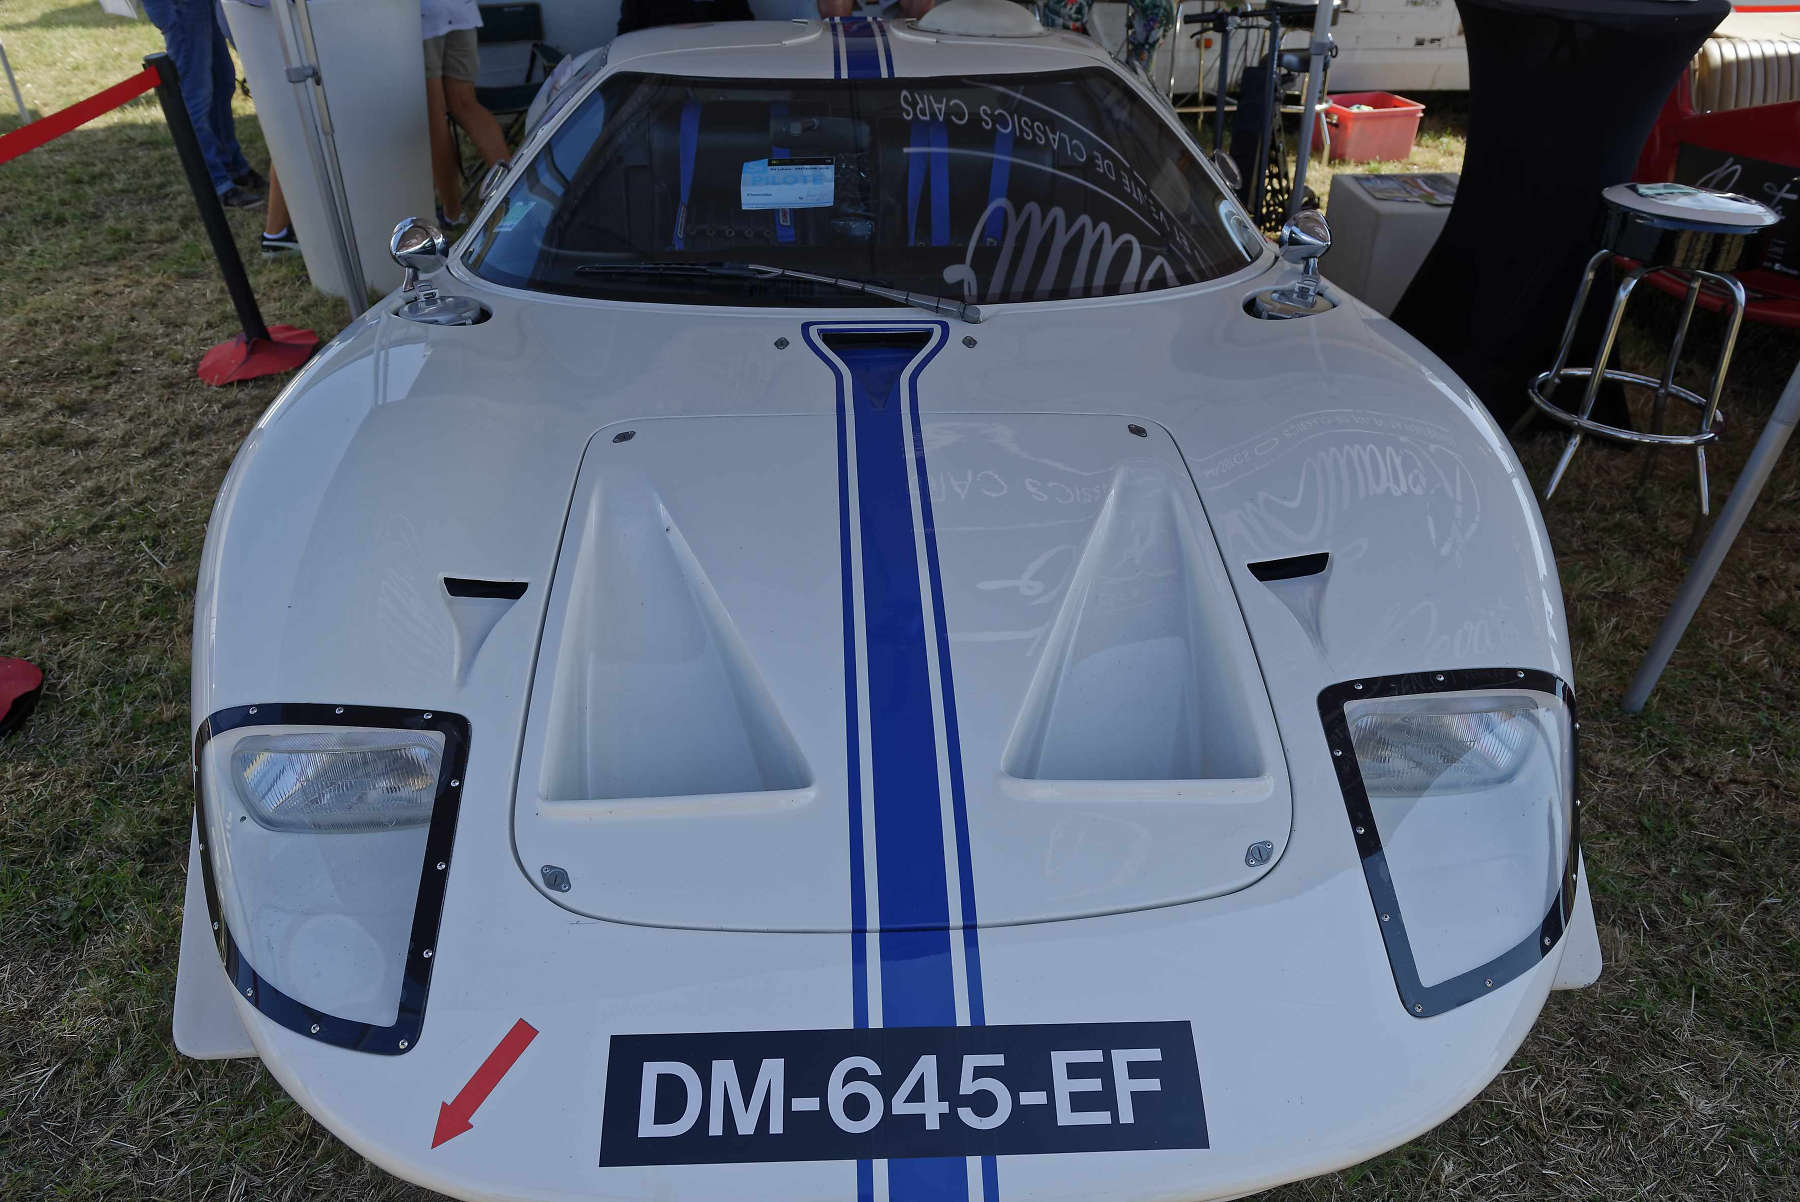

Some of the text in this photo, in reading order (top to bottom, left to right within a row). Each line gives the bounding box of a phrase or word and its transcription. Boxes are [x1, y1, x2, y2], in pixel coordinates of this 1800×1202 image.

[901, 89, 969, 125] CARS
[978, 104, 1087, 163] CLASSICS
[1093, 151, 1116, 180] DE
[638, 1048, 1162, 1137] DM-645-EF
